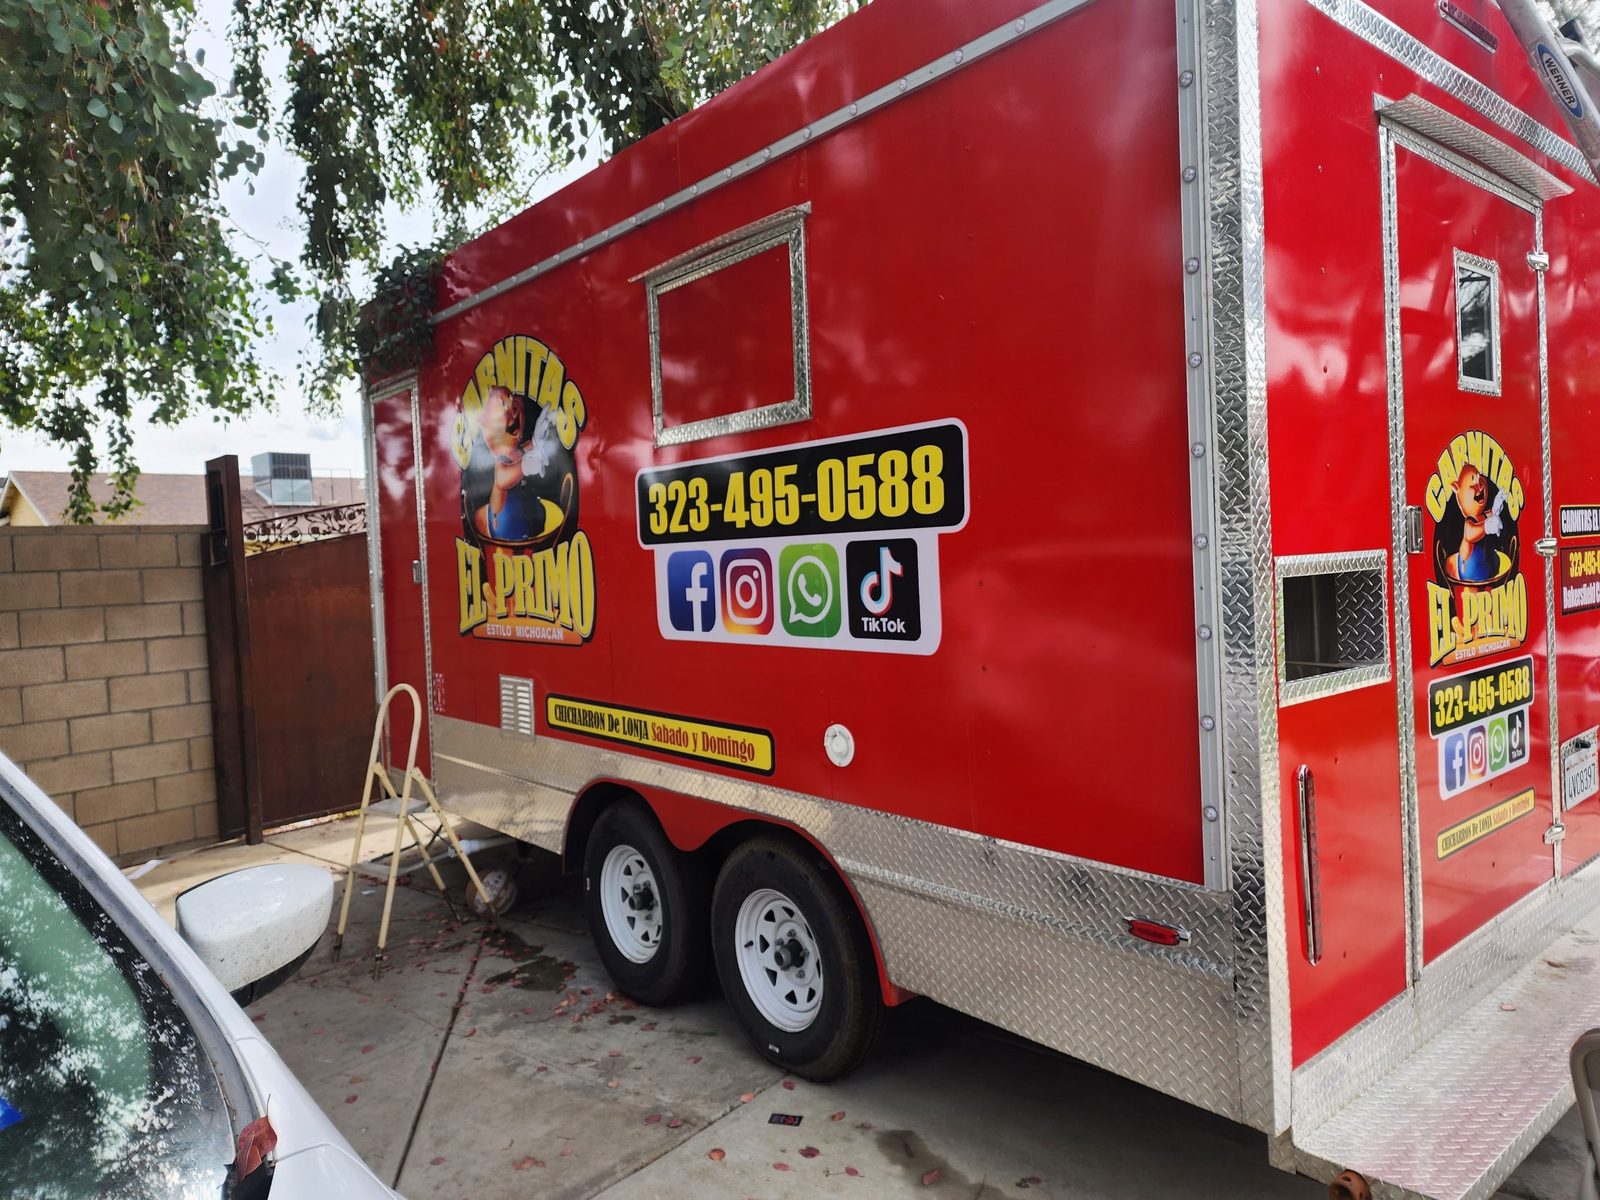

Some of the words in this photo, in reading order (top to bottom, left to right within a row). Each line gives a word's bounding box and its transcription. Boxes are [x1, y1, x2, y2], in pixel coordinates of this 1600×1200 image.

[1544, 57, 1576, 105] WERNER
[450, 335, 586, 470] CARNITAS
[648, 444, 946, 535] 323-495-0588
[1425, 431, 1524, 523] CARNITAS
[1561, 509, 1592, 533] CARNITAS
[455, 537, 488, 632] EL
[493, 530, 595, 638] PRIMO
[486, 623, 512, 637] ESTILO
[515, 625, 564, 640] MICHOACAN
[861, 616, 906, 633] TikTok
[1427, 580, 1456, 667] EL
[1461, 572, 1527, 644] PRIMO
[1455, 646, 1477, 660] ESTILO
[1478, 639, 1511, 655] MICHOACAN
[1434, 665, 1531, 728] 323-495-0588
[554, 703, 606, 730] CHICHARRON
[608, 714, 620, 732] De
[622, 715, 649, 741] LONJA
[651, 722, 689, 748] Sabado
[692, 732, 699, 750] y
[702, 731, 755, 763] Domingo
